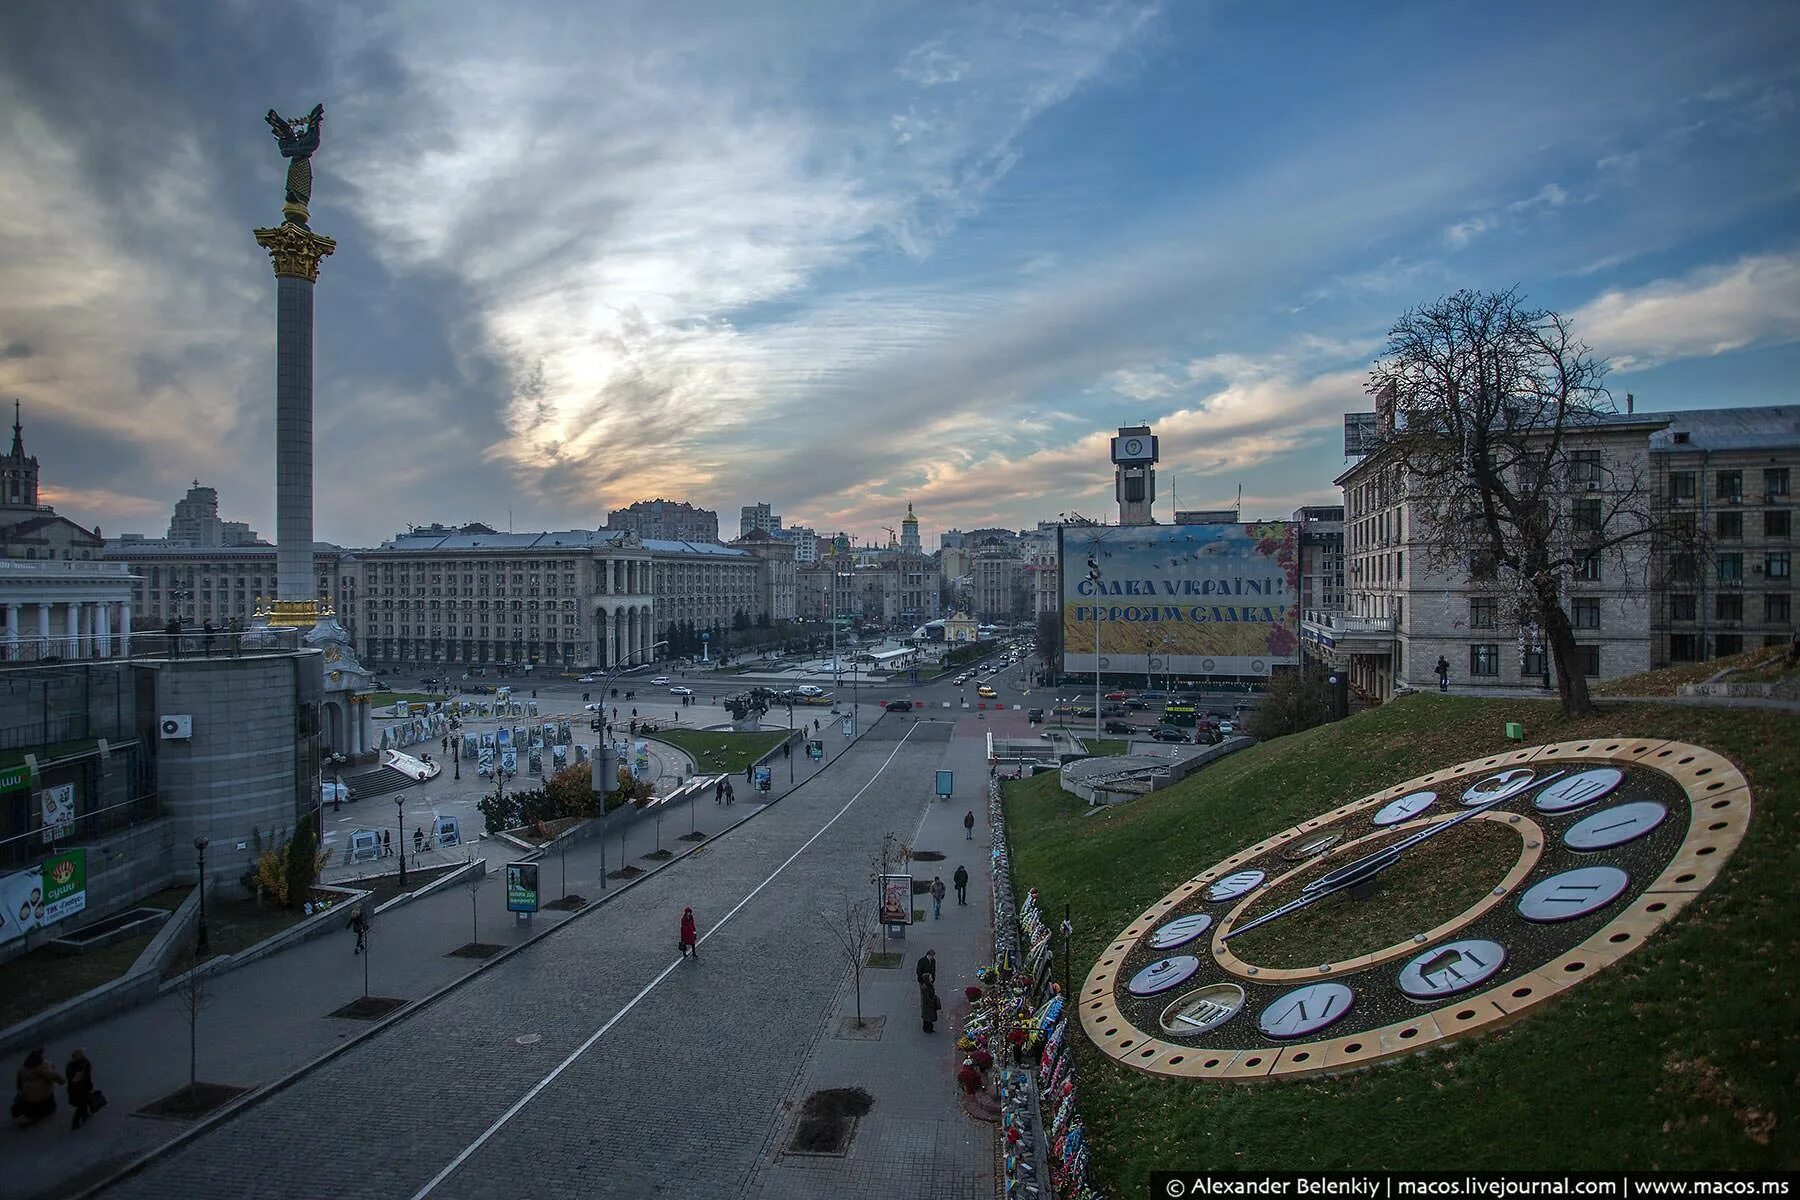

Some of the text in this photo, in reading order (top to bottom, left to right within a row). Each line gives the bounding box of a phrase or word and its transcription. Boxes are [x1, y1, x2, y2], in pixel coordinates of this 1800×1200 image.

[1077, 577, 1284, 598] СЛАВА УКРАЇНІ!
[1076, 605, 1285, 624] ГЕРОЯМ СЛАВА!
[1550, 777, 1605, 802] XII
[1394, 797, 1414, 814] X
[1591, 818, 1637, 834] I
[1543, 885, 1601, 904] II
